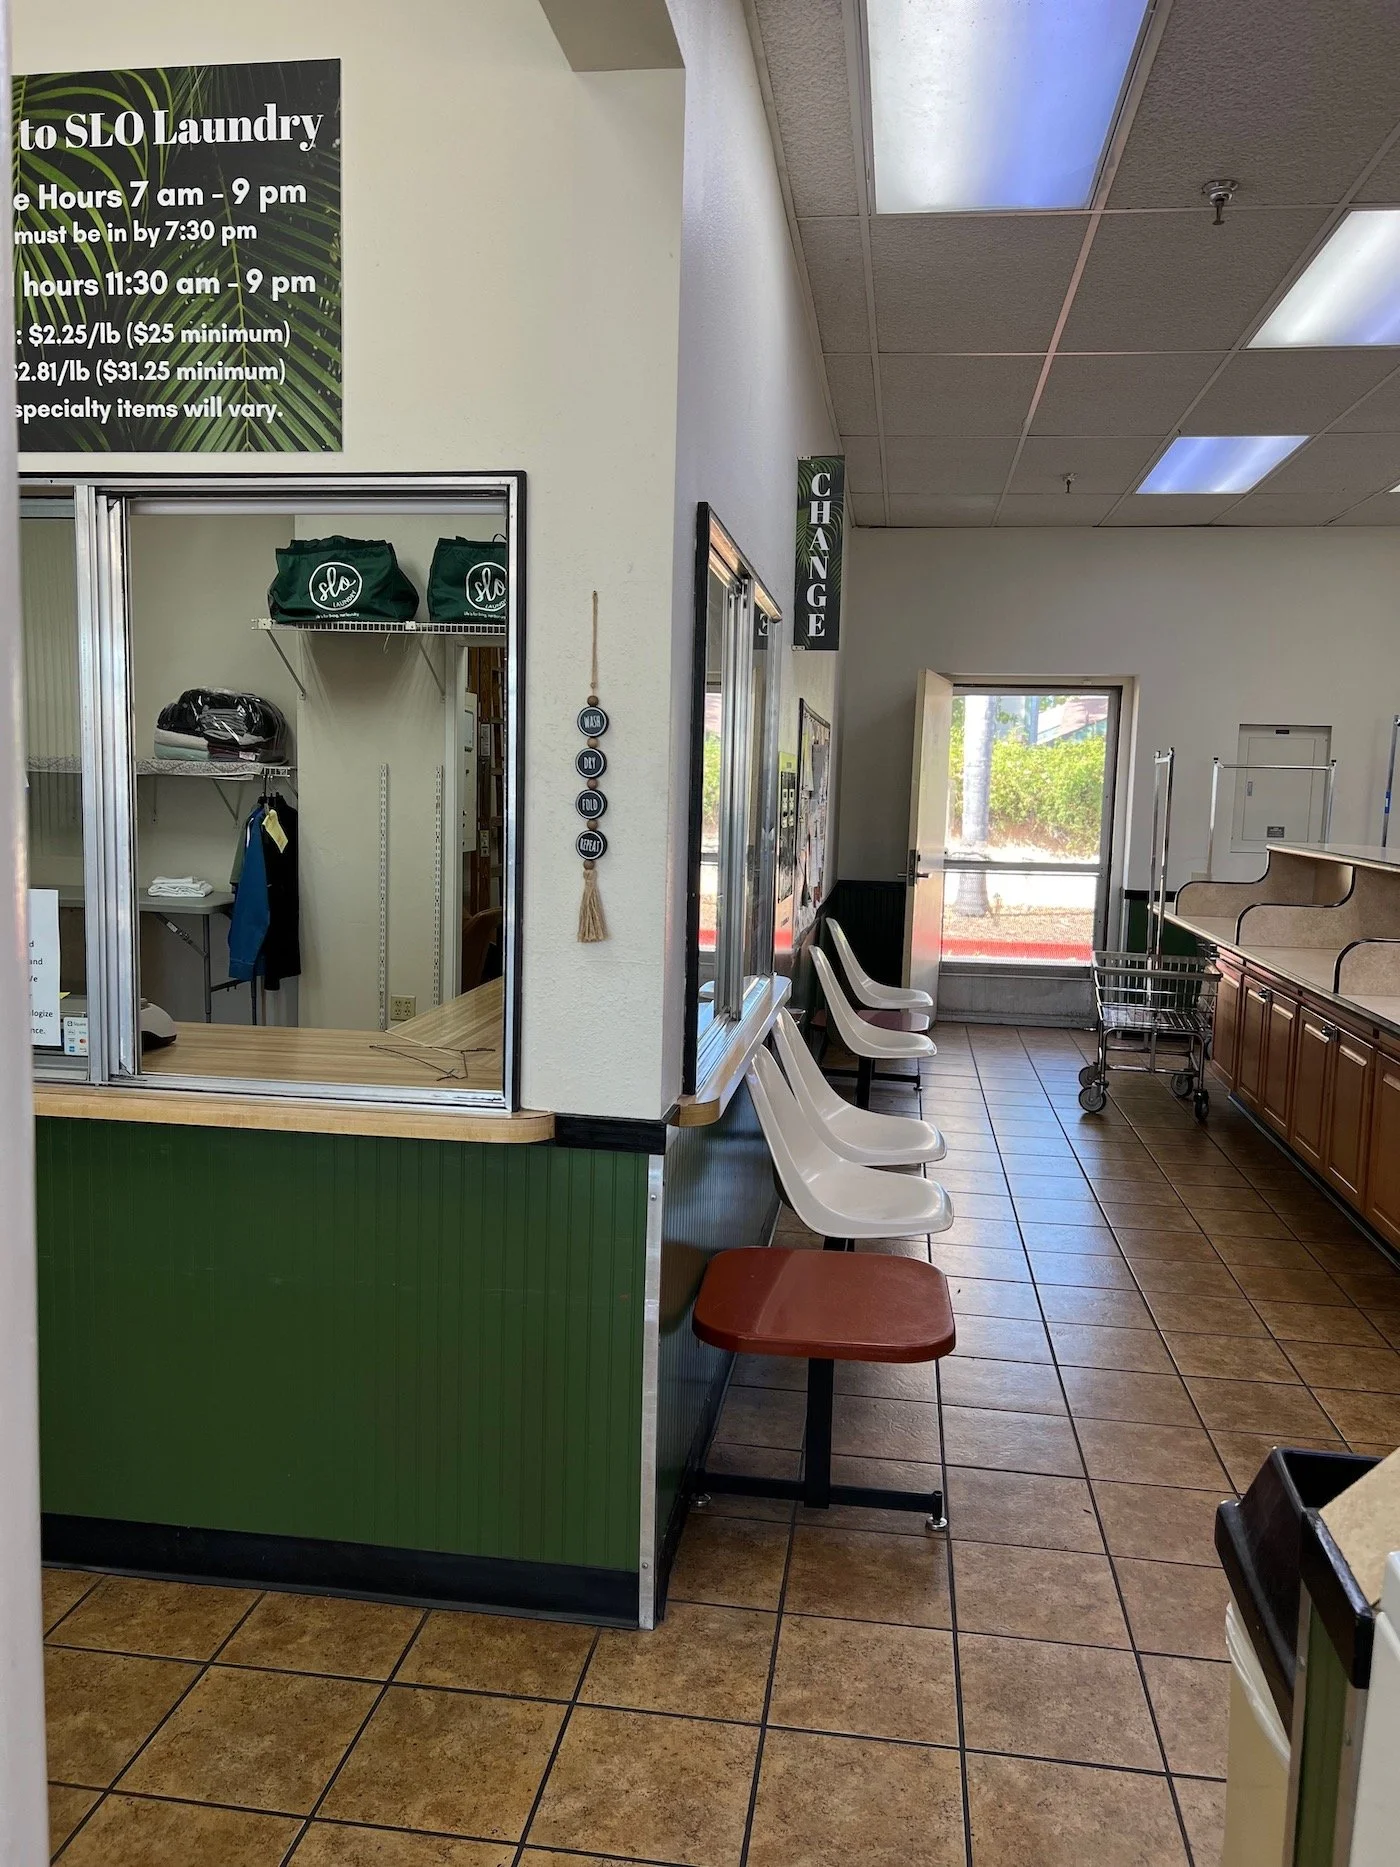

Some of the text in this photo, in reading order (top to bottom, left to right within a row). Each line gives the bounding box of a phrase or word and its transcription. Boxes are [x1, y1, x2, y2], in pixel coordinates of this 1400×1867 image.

[19, 104, 323, 151] to SLO Laundry
[39, 184, 122, 209] Hours
[130, 181, 148, 206] 7
[157, 188, 203, 206] am
[232, 178, 249, 204] 9
[260, 185, 306, 212] pm
[15, 220, 256, 247] must be in by 7:30 pm
[24, 271, 98, 296] hours
[106, 270, 167, 295] 11:30
[177, 278, 219, 294] am
[247, 269, 263, 293] 9
[272, 276, 315, 301] pm
[29, 322, 120, 349] $2.25/lb
[127, 322, 174, 348] ($25
[181, 321, 289, 347] minimum)
[97, 359, 170, 386] ($31.25
[177, 358, 285, 385] minimum)
[15, 396, 283, 424] specialty items will vary.
[807, 472, 832, 637] CHANGE
[318, 566, 357, 602] slo
[332, 589, 357, 608] LAUNDRY
[584, 715, 600, 728] WASH
[584, 757, 596, 769] DRY
[582, 799, 597, 811] FOLD
[580, 838, 600, 852] REPEAT
